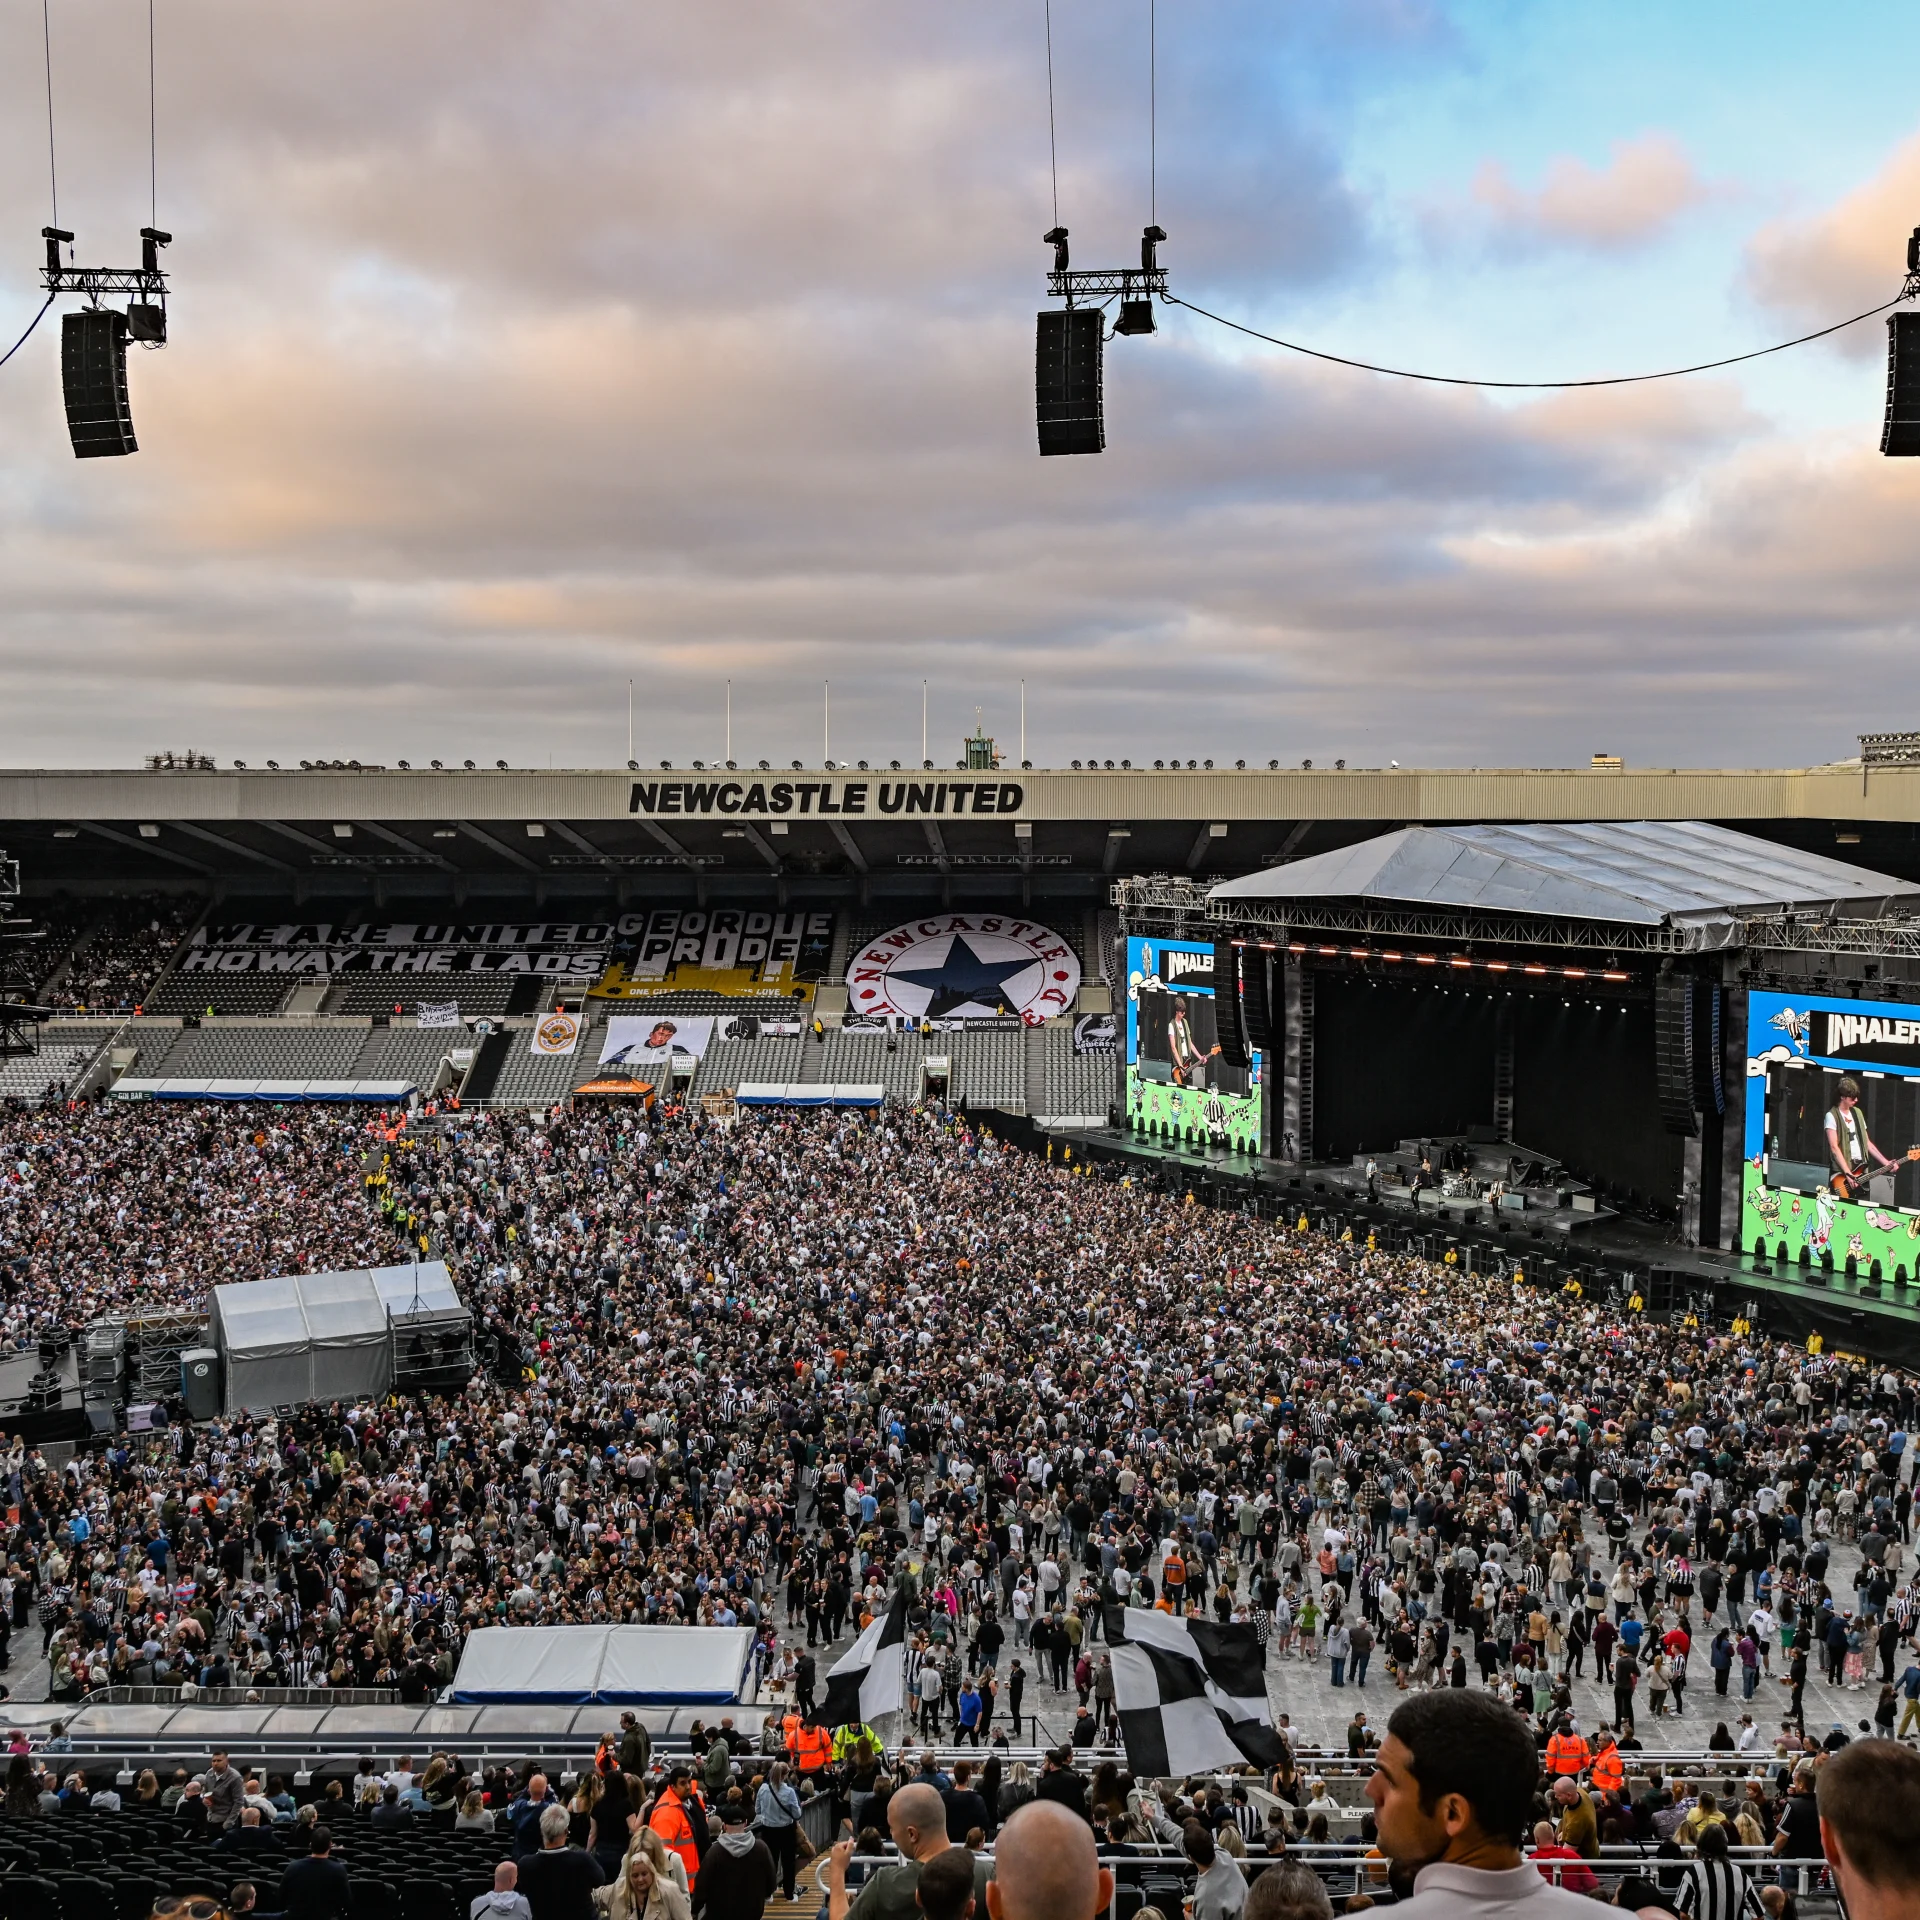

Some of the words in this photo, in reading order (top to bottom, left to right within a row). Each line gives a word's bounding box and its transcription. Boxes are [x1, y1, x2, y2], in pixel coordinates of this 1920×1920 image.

[629, 783, 868, 814] NEWCASTLE
[878, 783, 1023, 814] UNITED
[206, 924, 281, 945] WE
[286, 924, 393, 946] ARE
[412, 924, 610, 944] UNITED
[617, 911, 833, 935] GEORDIE
[642, 937, 798, 962] PRIDE
[854, 917, 1069, 983] NEWCASTLE
[182, 950, 361, 971] HOWAY
[368, 950, 458, 972] THE
[470, 953, 604, 974] LADS
[1168, 952, 1215, 982] INHALE
[756, 988, 781, 996] LOVE
[1075, 1041, 1116, 1050] NEWCAST
[1827, 1014, 1920, 1056] INHALER
[1081, 1047, 1116, 1055] UNITE
[118, 1092, 129, 1100] GIN
[130, 1092, 143, 1100] BAR
